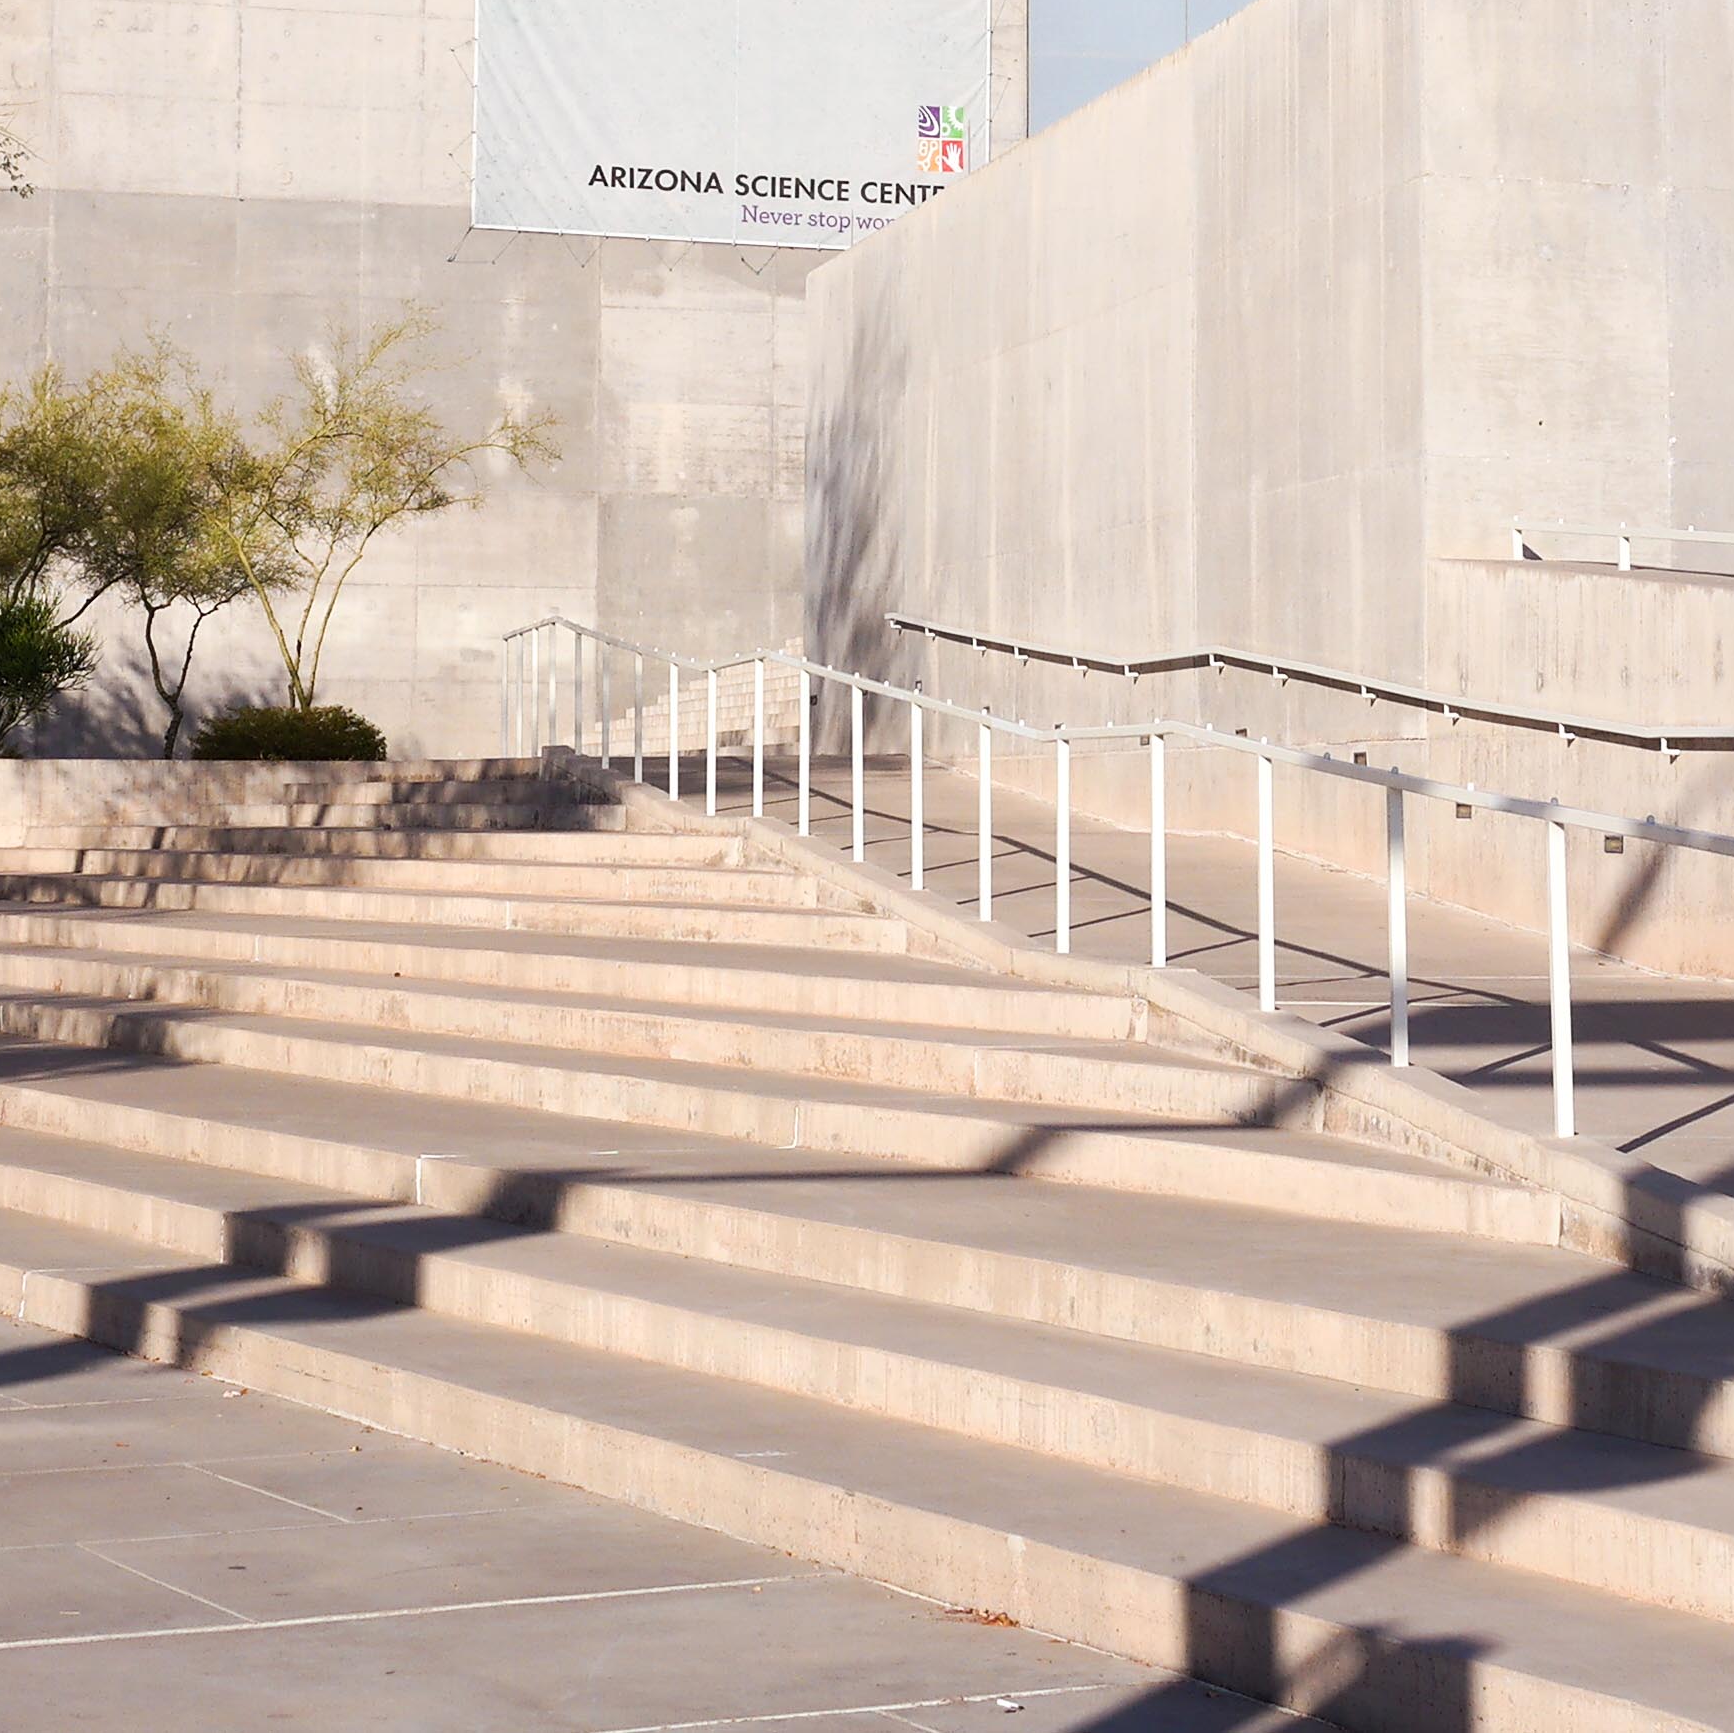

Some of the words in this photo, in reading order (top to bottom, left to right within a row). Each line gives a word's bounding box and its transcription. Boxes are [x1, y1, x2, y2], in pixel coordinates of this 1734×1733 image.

[588, 164, 724, 195] ARIZONA
[734, 174, 850, 202] SCIENCE
[741, 204, 803, 226] Never
[807, 210, 851, 233] stop
